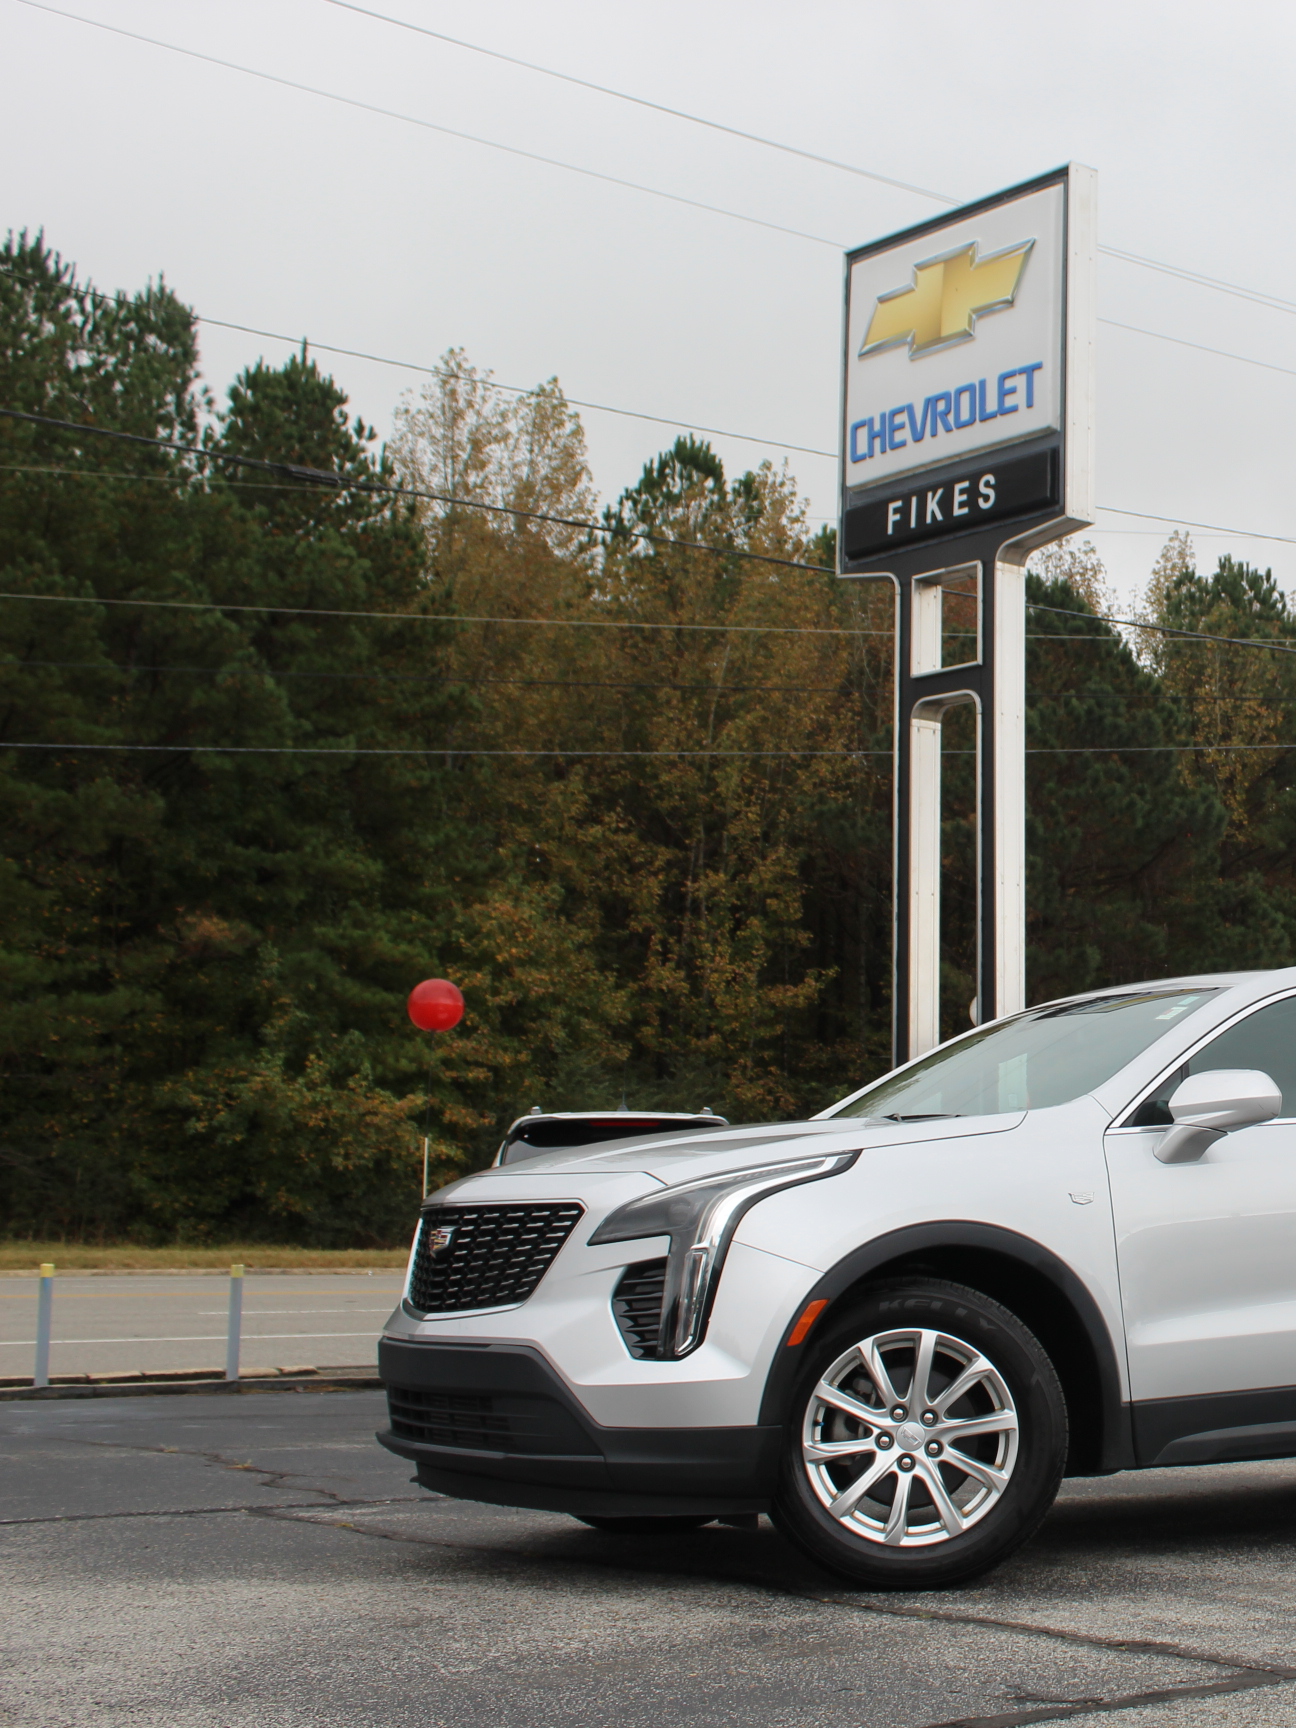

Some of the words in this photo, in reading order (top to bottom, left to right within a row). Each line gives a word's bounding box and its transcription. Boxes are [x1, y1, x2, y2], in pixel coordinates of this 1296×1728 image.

[850, 361, 1043, 463] CHEVROLET
[887, 473, 996, 535] FIKES
[879, 1298, 998, 1330] KELLY
